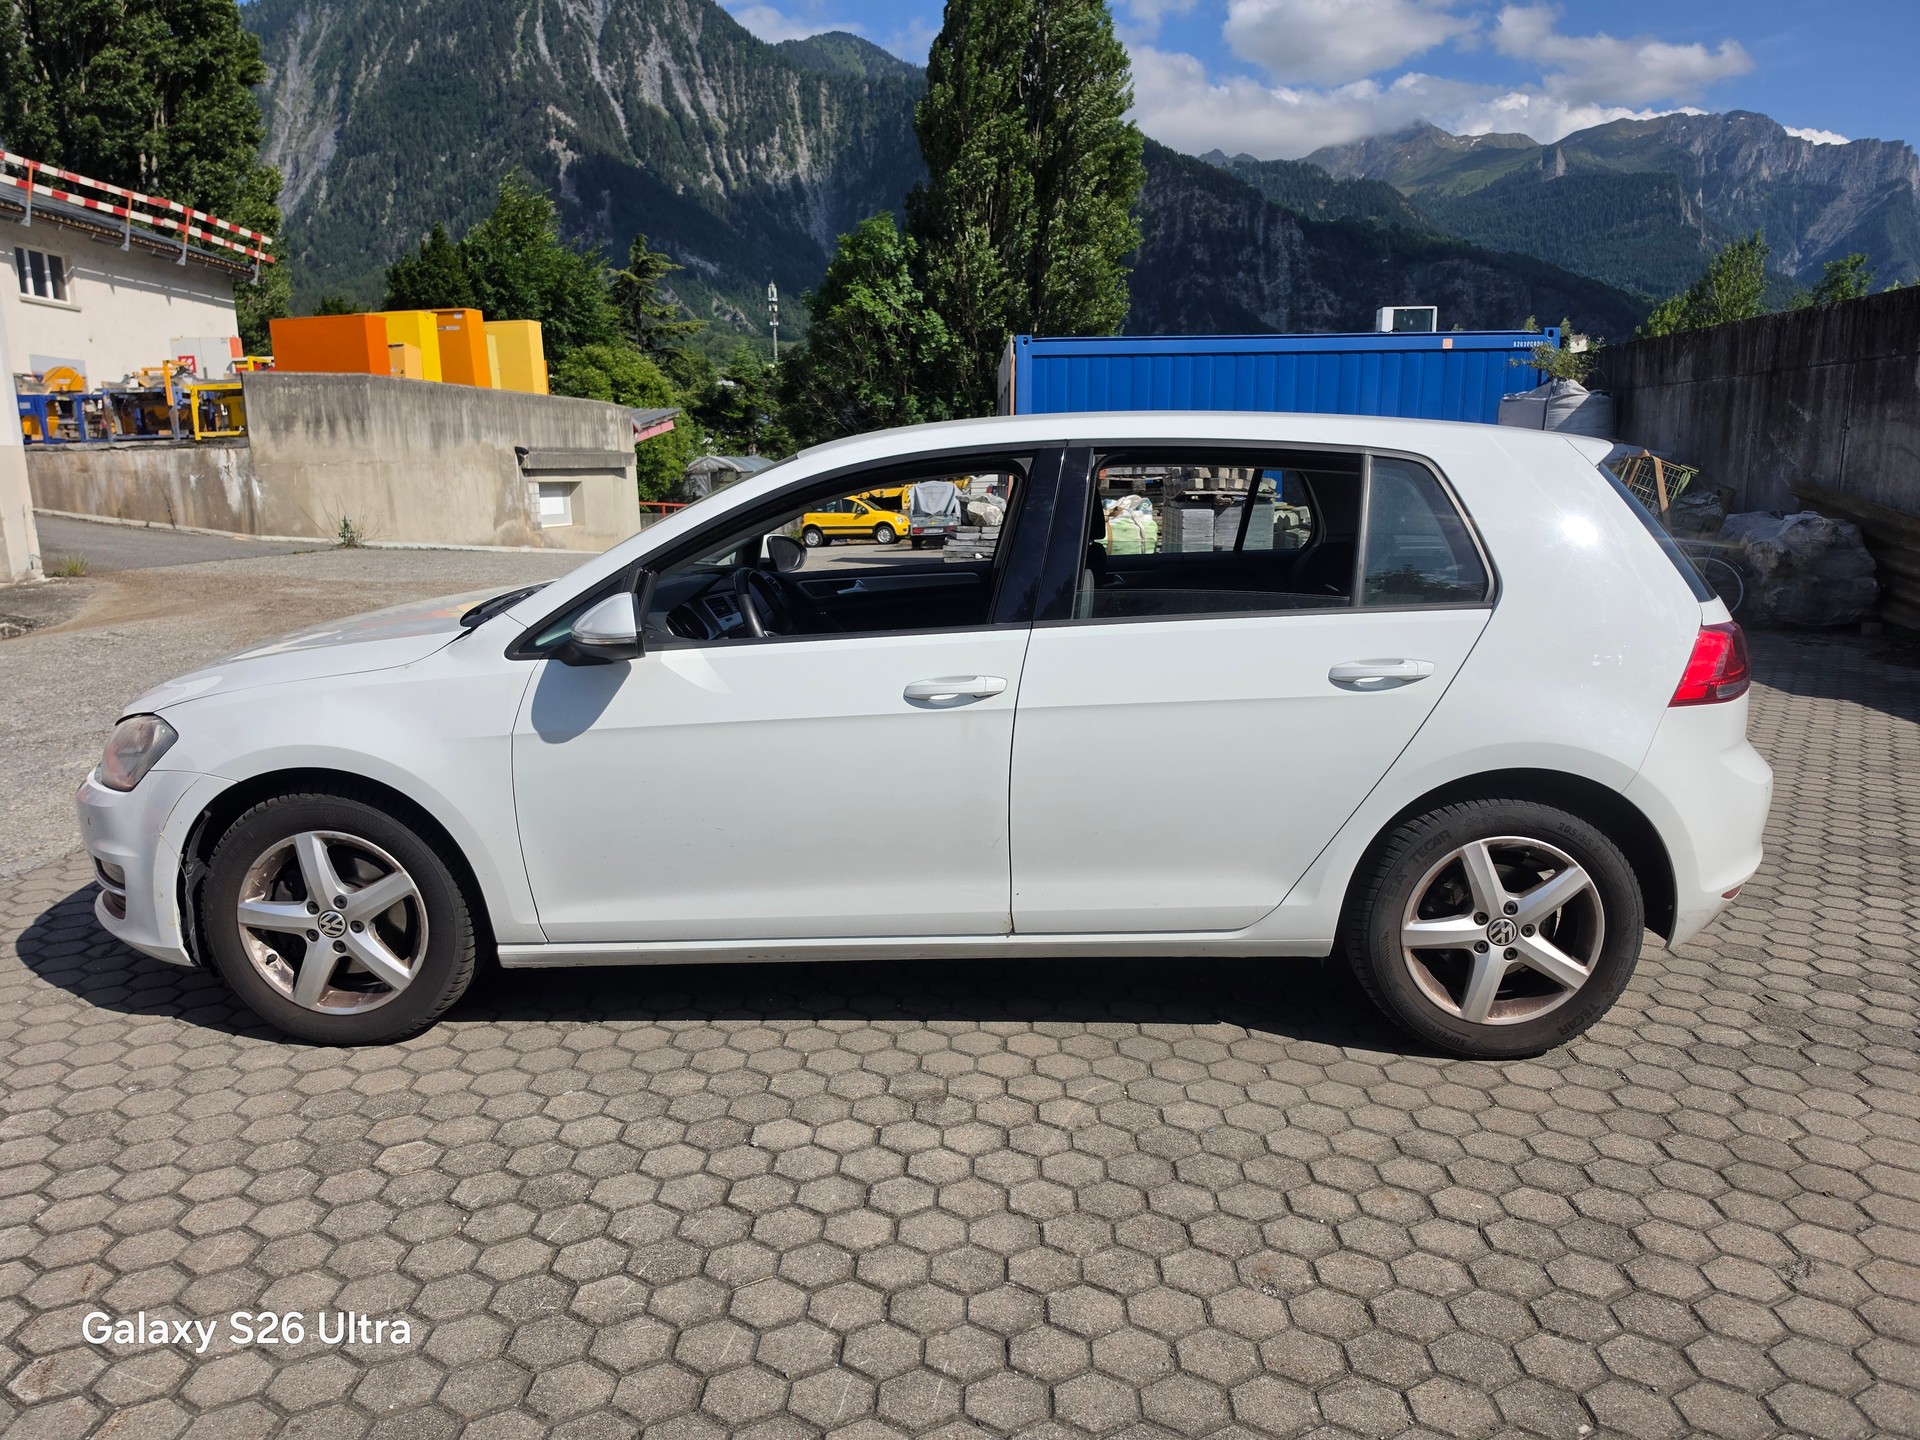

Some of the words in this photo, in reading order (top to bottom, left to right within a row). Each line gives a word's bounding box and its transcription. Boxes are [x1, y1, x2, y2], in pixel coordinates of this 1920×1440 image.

[1408, 829, 1452, 864] TECAR
[1557, 822, 1593, 846] 205/55
[1557, 1002, 1601, 1035] TECAR
